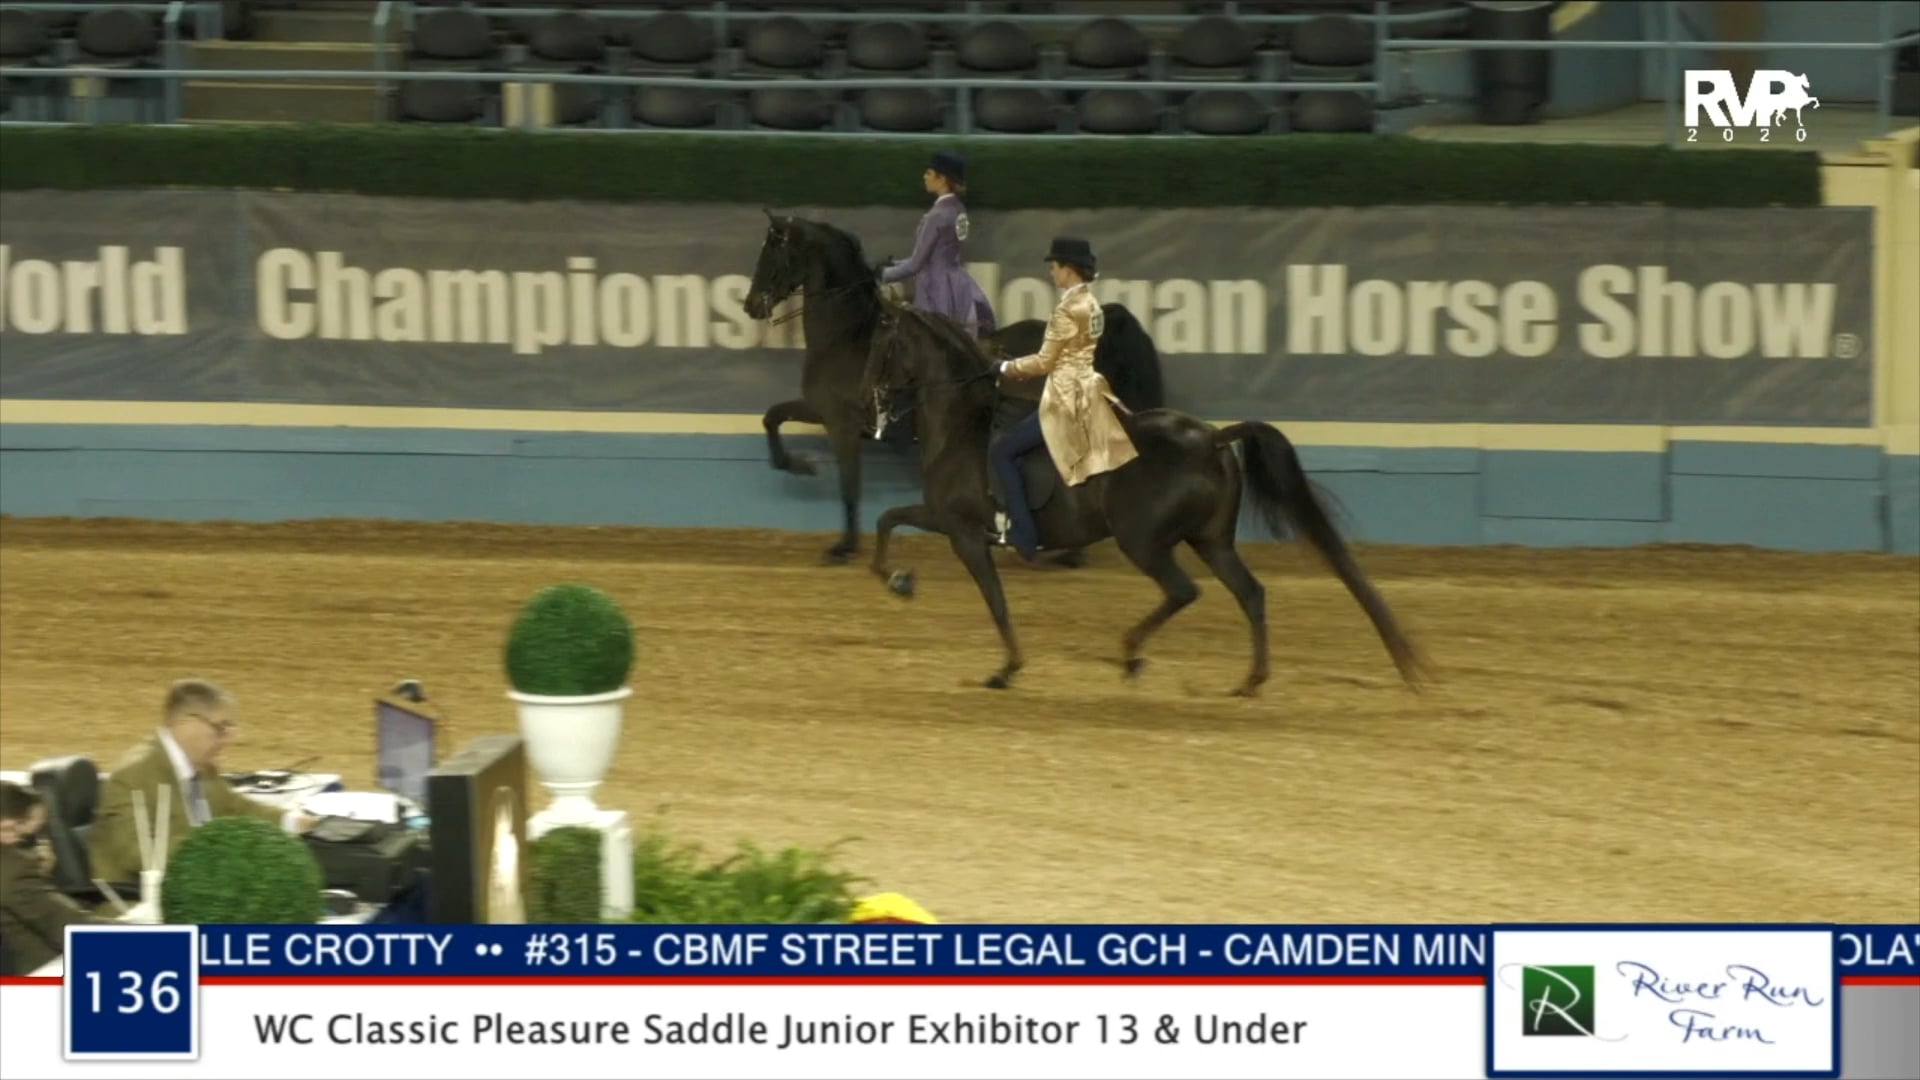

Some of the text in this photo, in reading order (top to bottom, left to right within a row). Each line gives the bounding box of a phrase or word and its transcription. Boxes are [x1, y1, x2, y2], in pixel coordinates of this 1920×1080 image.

[0, 244, 188, 335] orld
[257, 247, 905, 355] Champions
[1287, 264, 1557, 357] Horse
